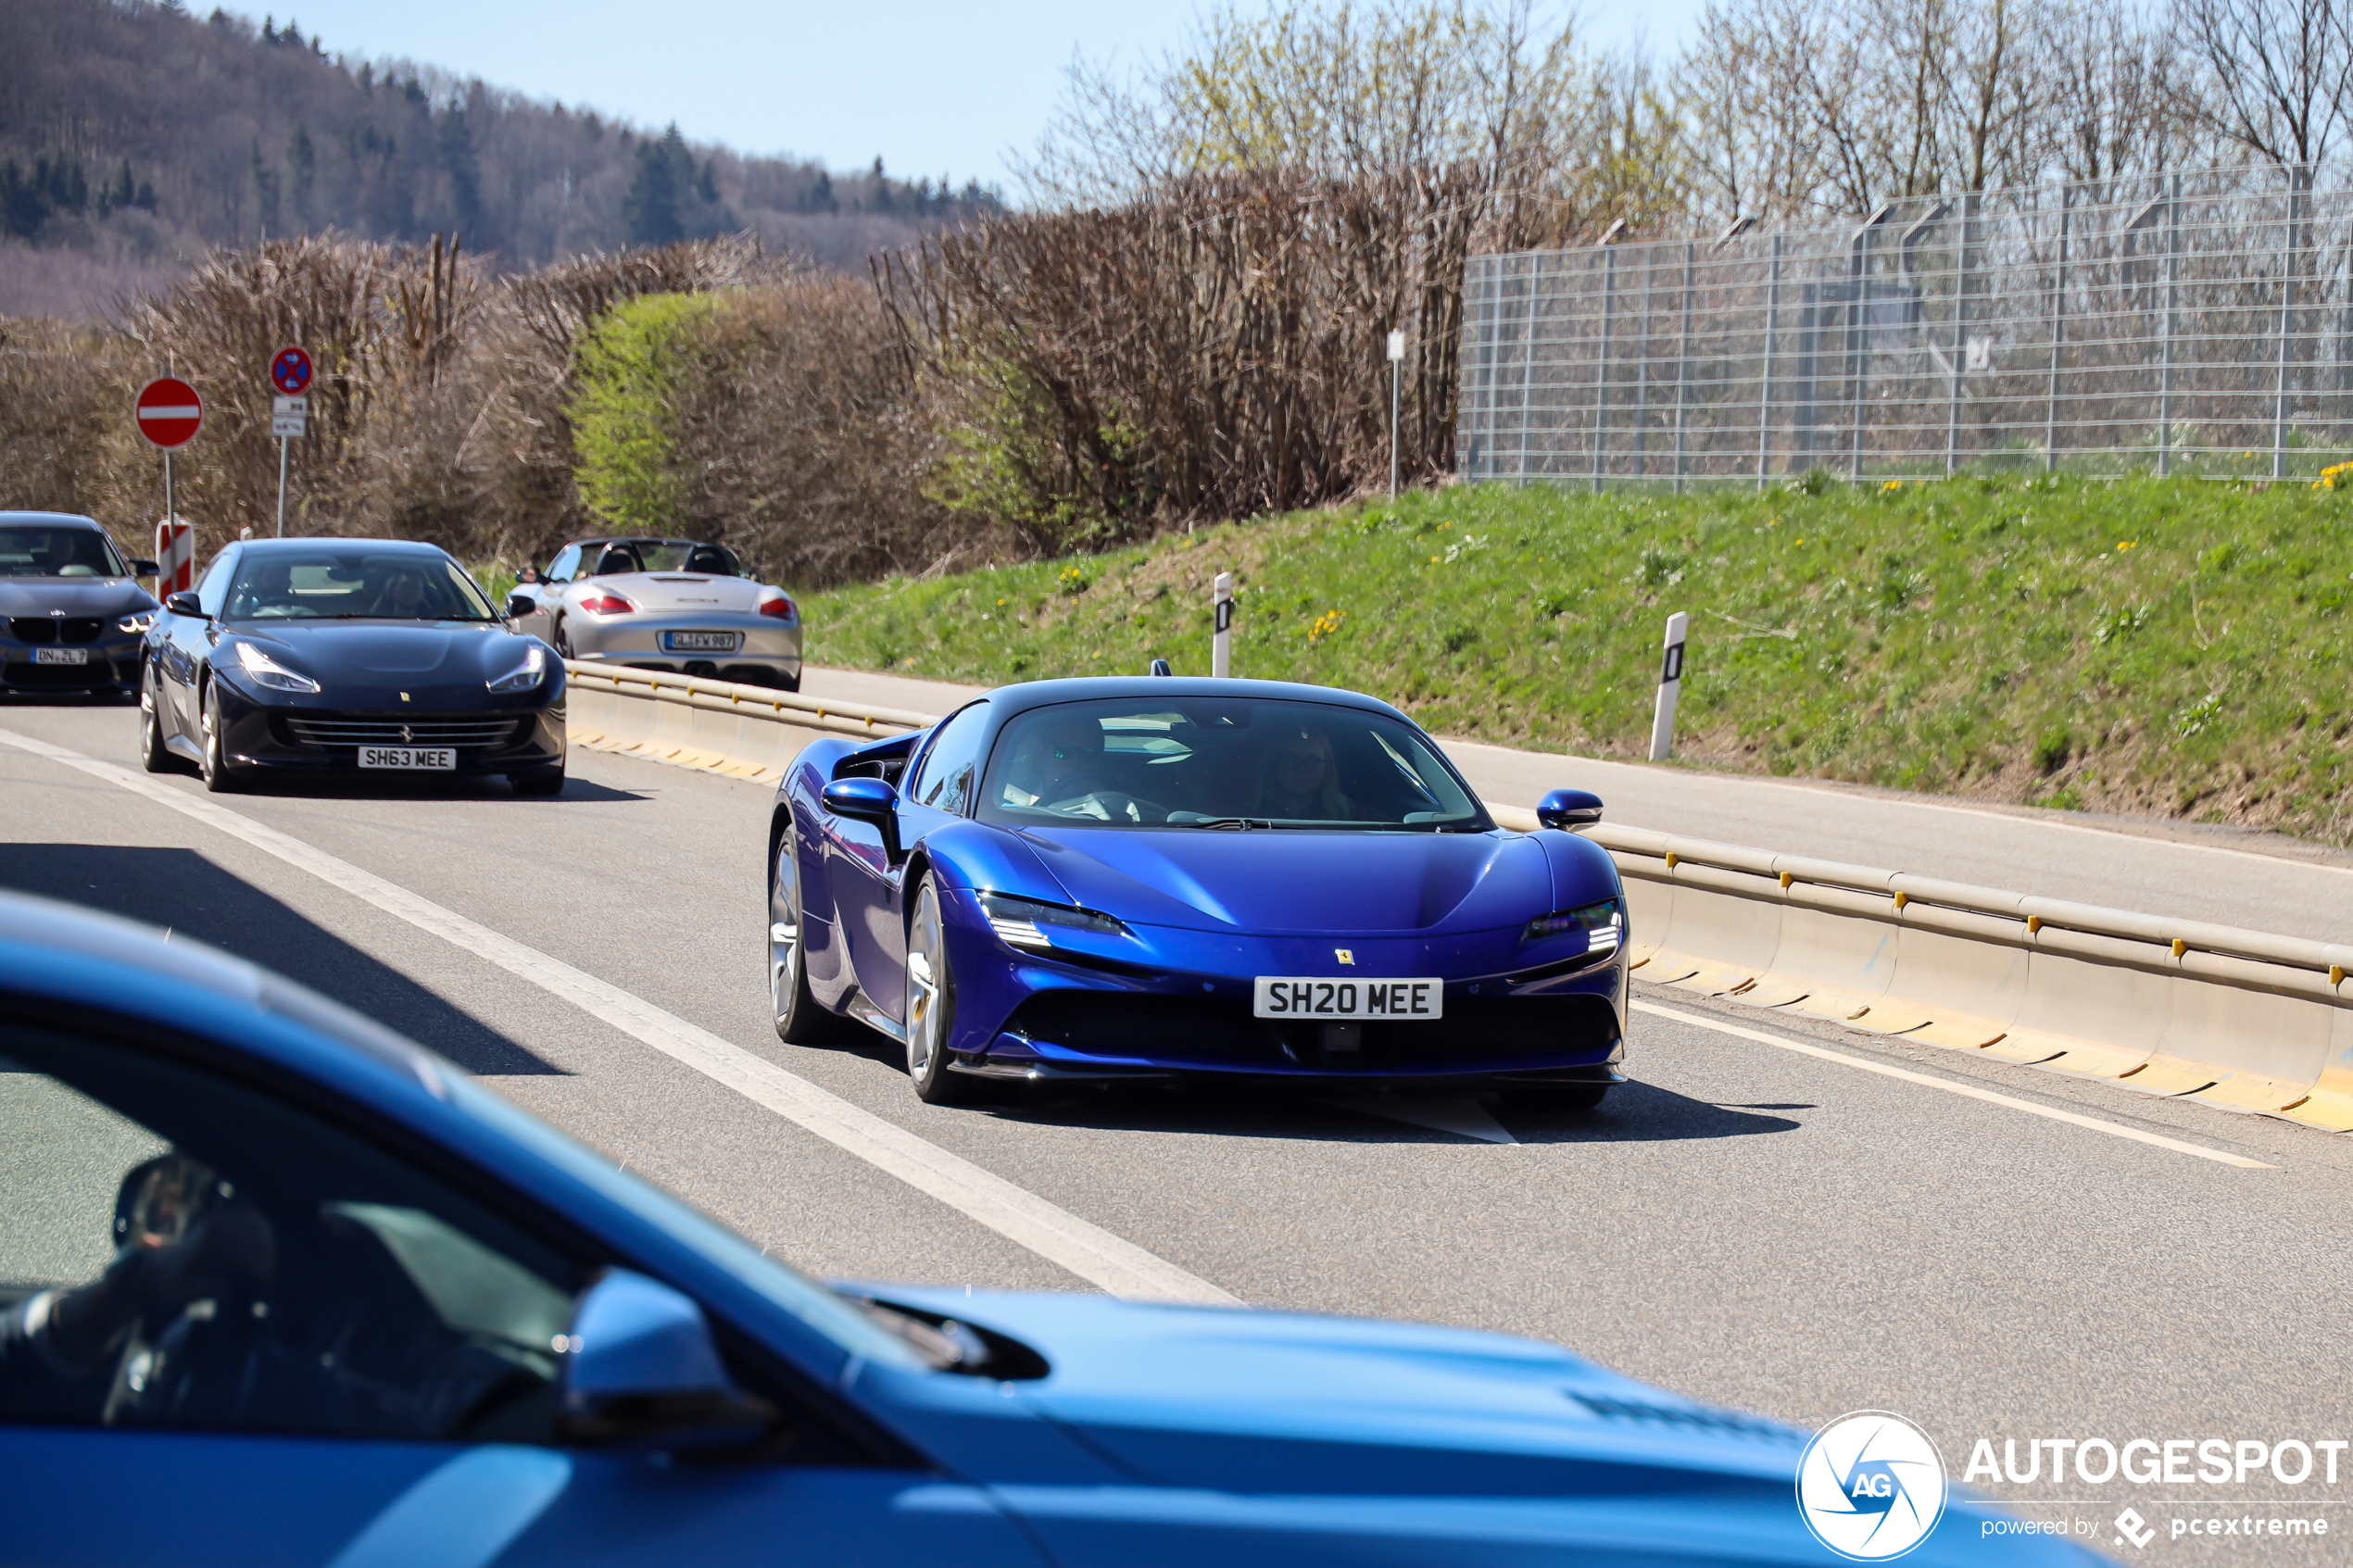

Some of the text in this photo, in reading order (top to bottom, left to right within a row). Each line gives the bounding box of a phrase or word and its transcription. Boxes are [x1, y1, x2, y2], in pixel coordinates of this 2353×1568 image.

[39, 649, 55, 661] DN
[366, 749, 449, 768] SH63 MEE
[1269, 983, 1429, 1013] SH20 MEE
